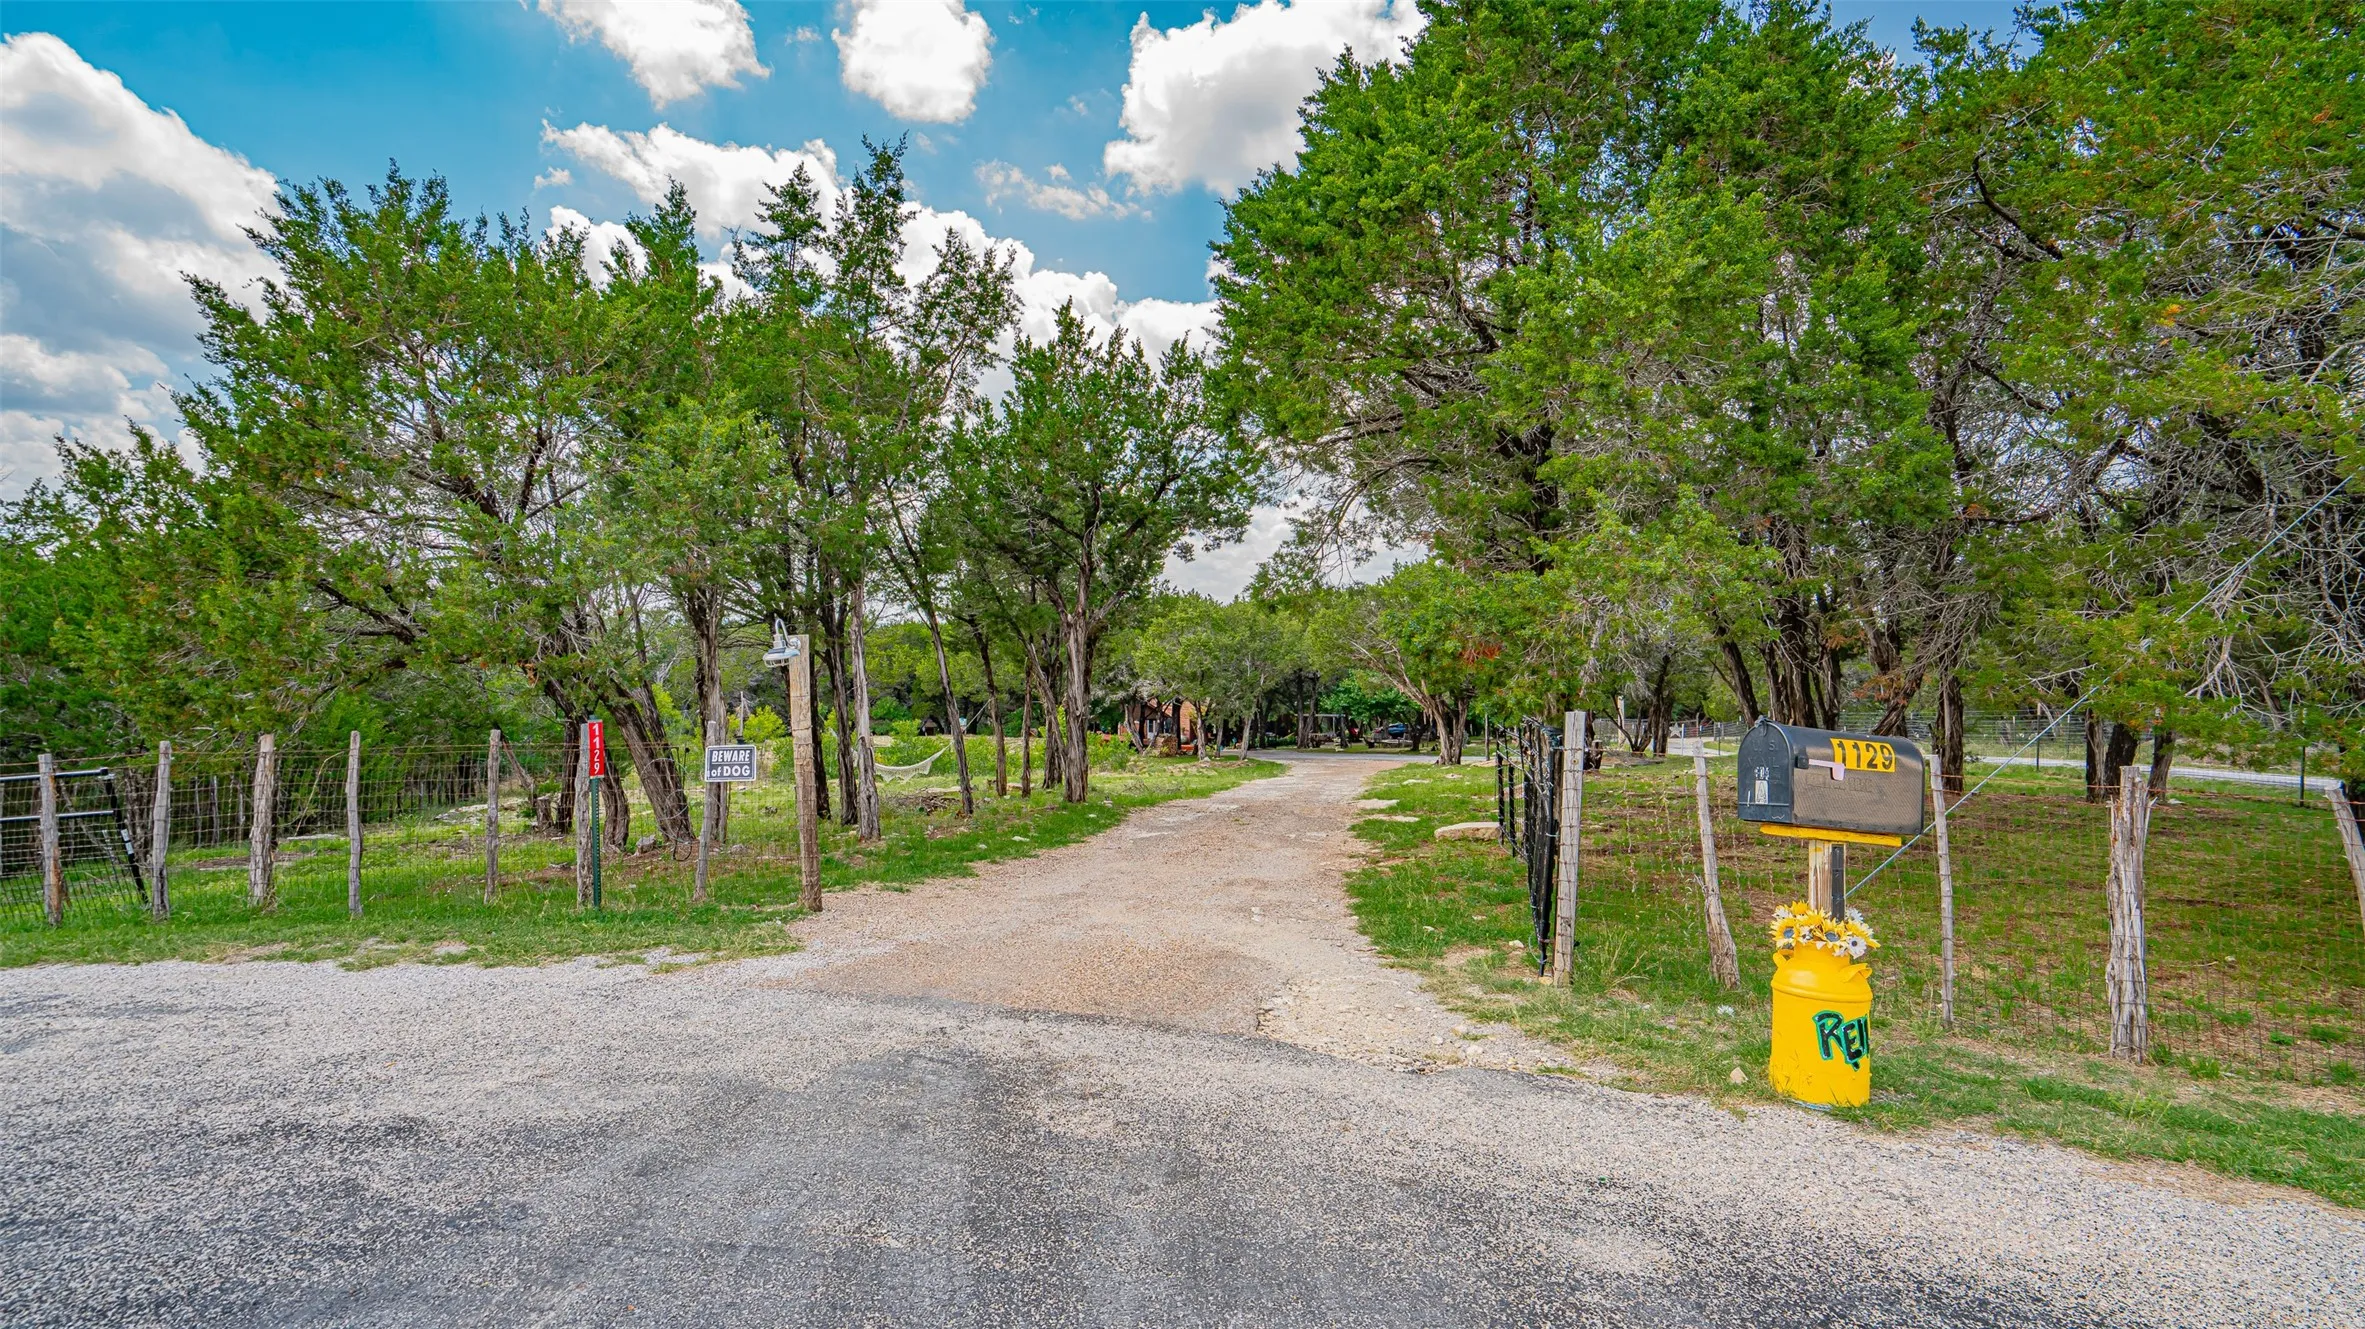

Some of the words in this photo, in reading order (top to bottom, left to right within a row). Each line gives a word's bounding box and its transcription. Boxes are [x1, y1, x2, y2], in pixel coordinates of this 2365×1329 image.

[592, 723, 600, 775] 1129
[711, 750, 751, 762] BEWARE
[1837, 740, 1893, 770] 1129
[711, 766, 721, 777] of
[723, 765, 751, 777] DOG
